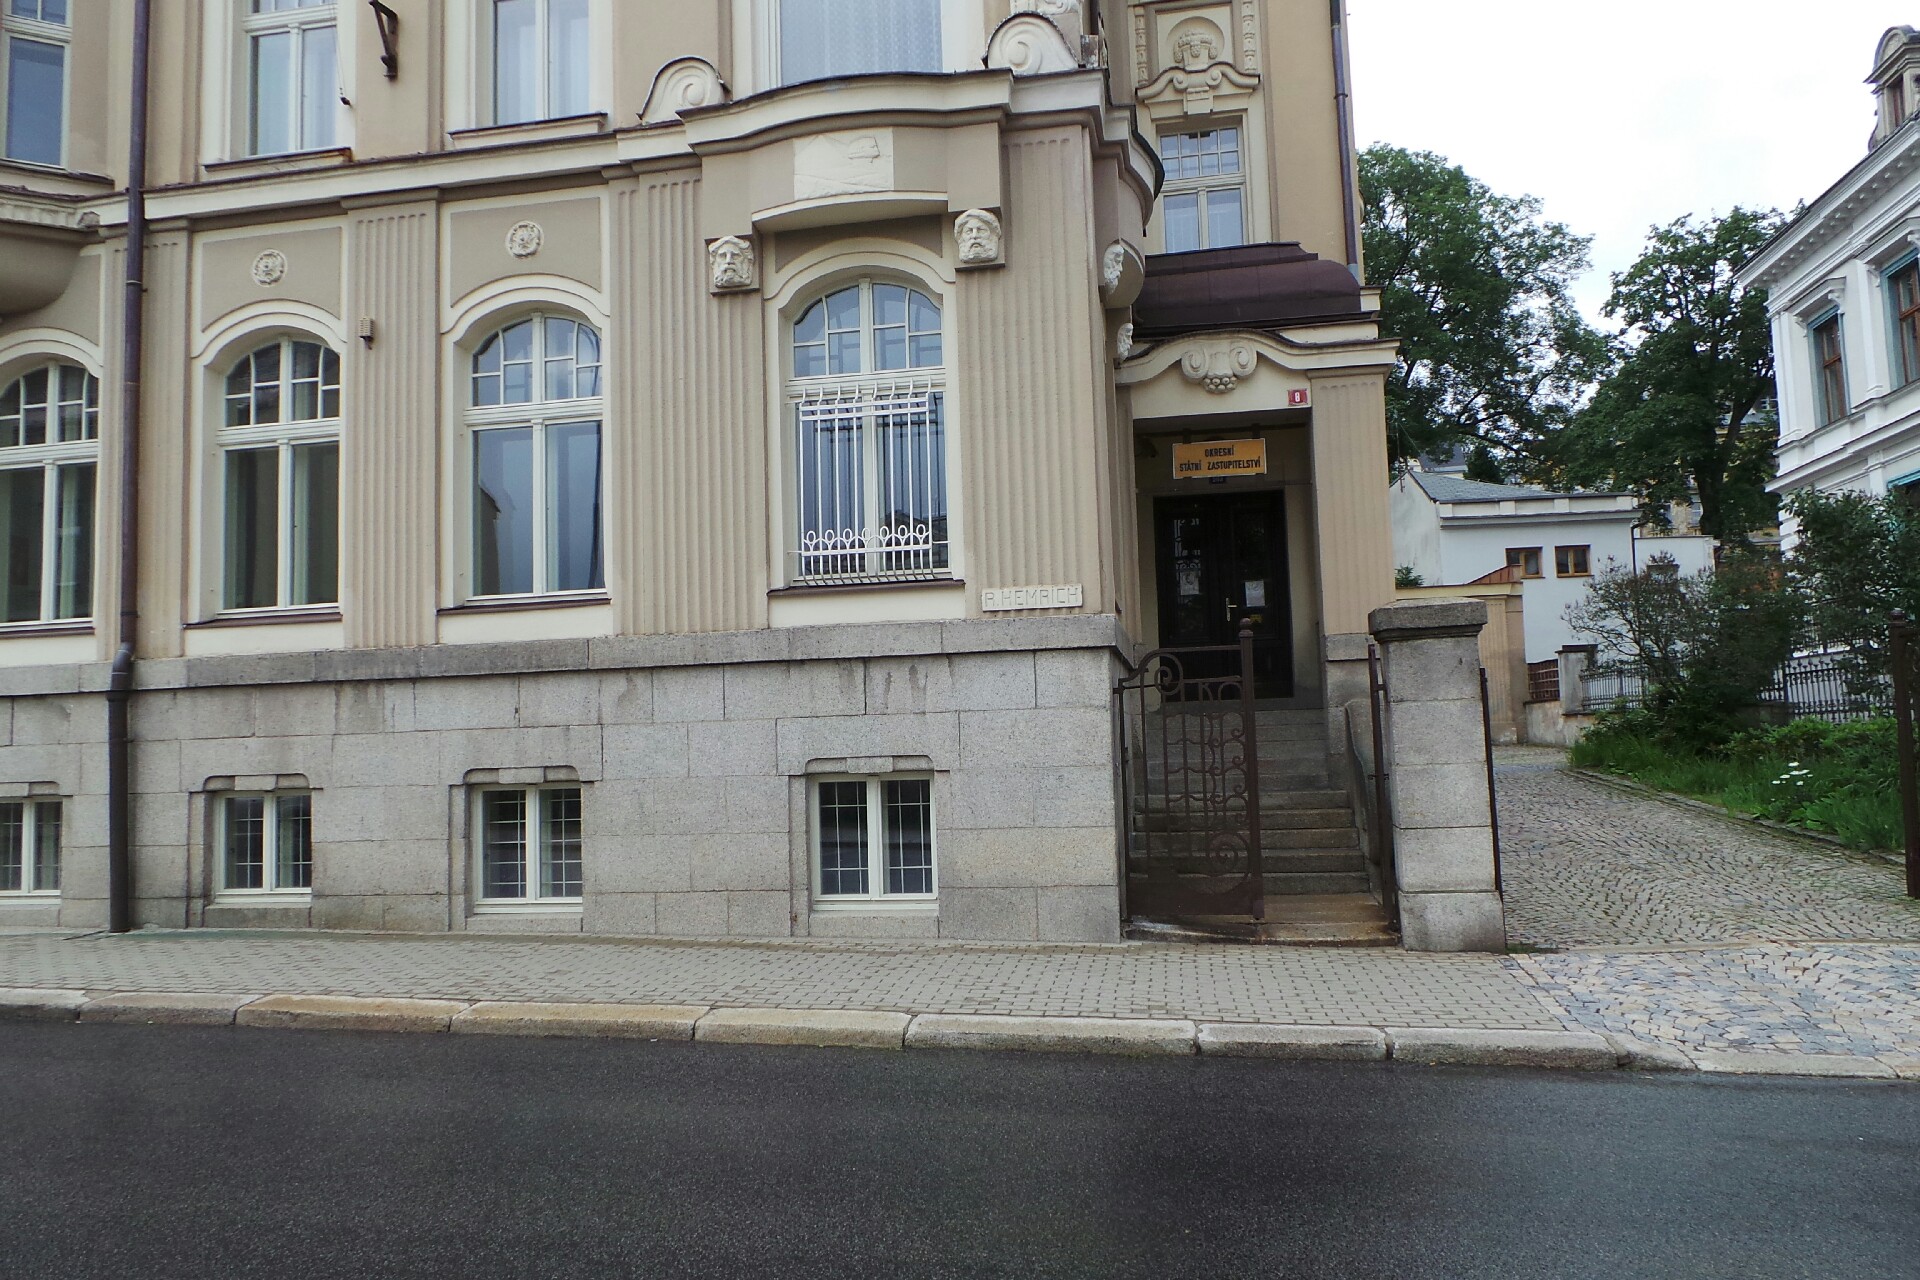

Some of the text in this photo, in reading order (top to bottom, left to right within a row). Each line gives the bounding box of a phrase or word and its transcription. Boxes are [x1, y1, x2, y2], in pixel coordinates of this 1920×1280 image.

[1295, 392, 1300, 402] 8
[1205, 445, 1234, 457] OKRESNÍ
[1180, 456, 1261, 472] STÁTNÍ ZASTUPITELSTVÍ
